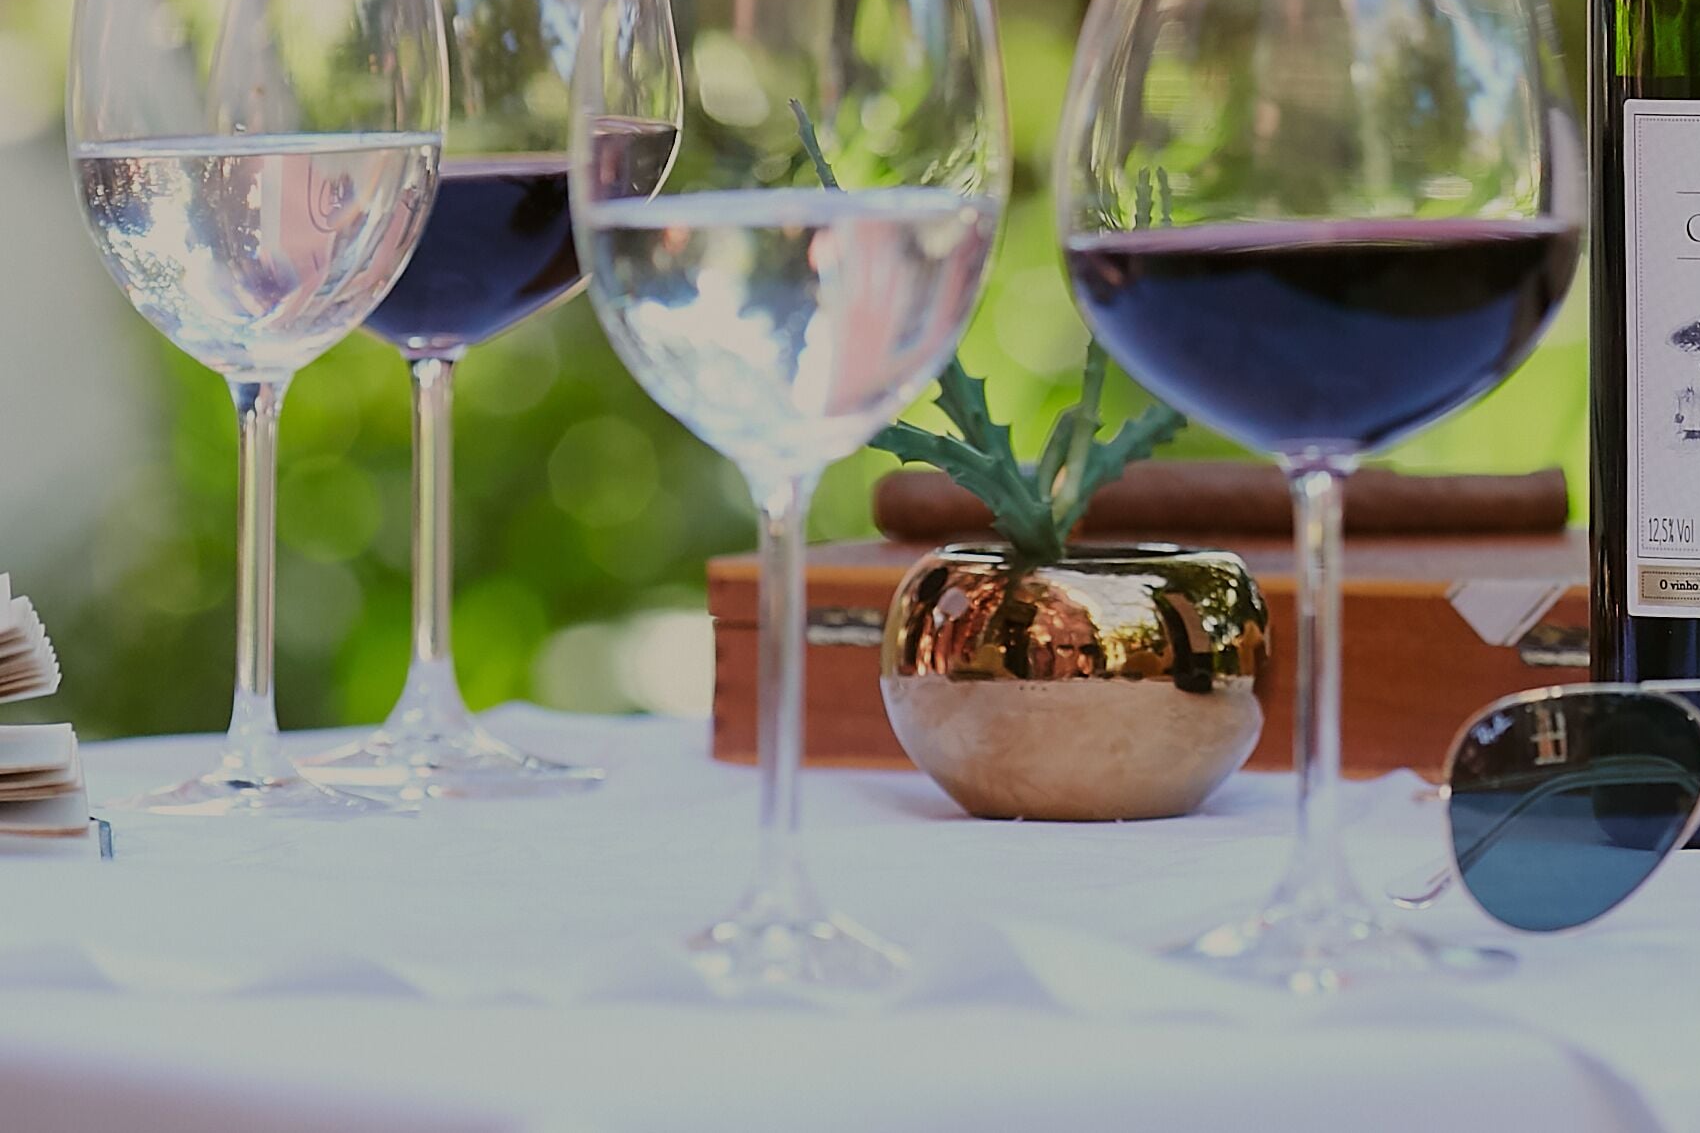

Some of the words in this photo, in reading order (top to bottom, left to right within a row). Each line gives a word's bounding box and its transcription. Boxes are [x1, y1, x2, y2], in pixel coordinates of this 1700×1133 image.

[1648, 517, 1674, 546] 12,5%
[1676, 517, 1694, 543] Vol
[1659, 579, 1668, 590] O
[1670, 580, 1699, 591] vinho
